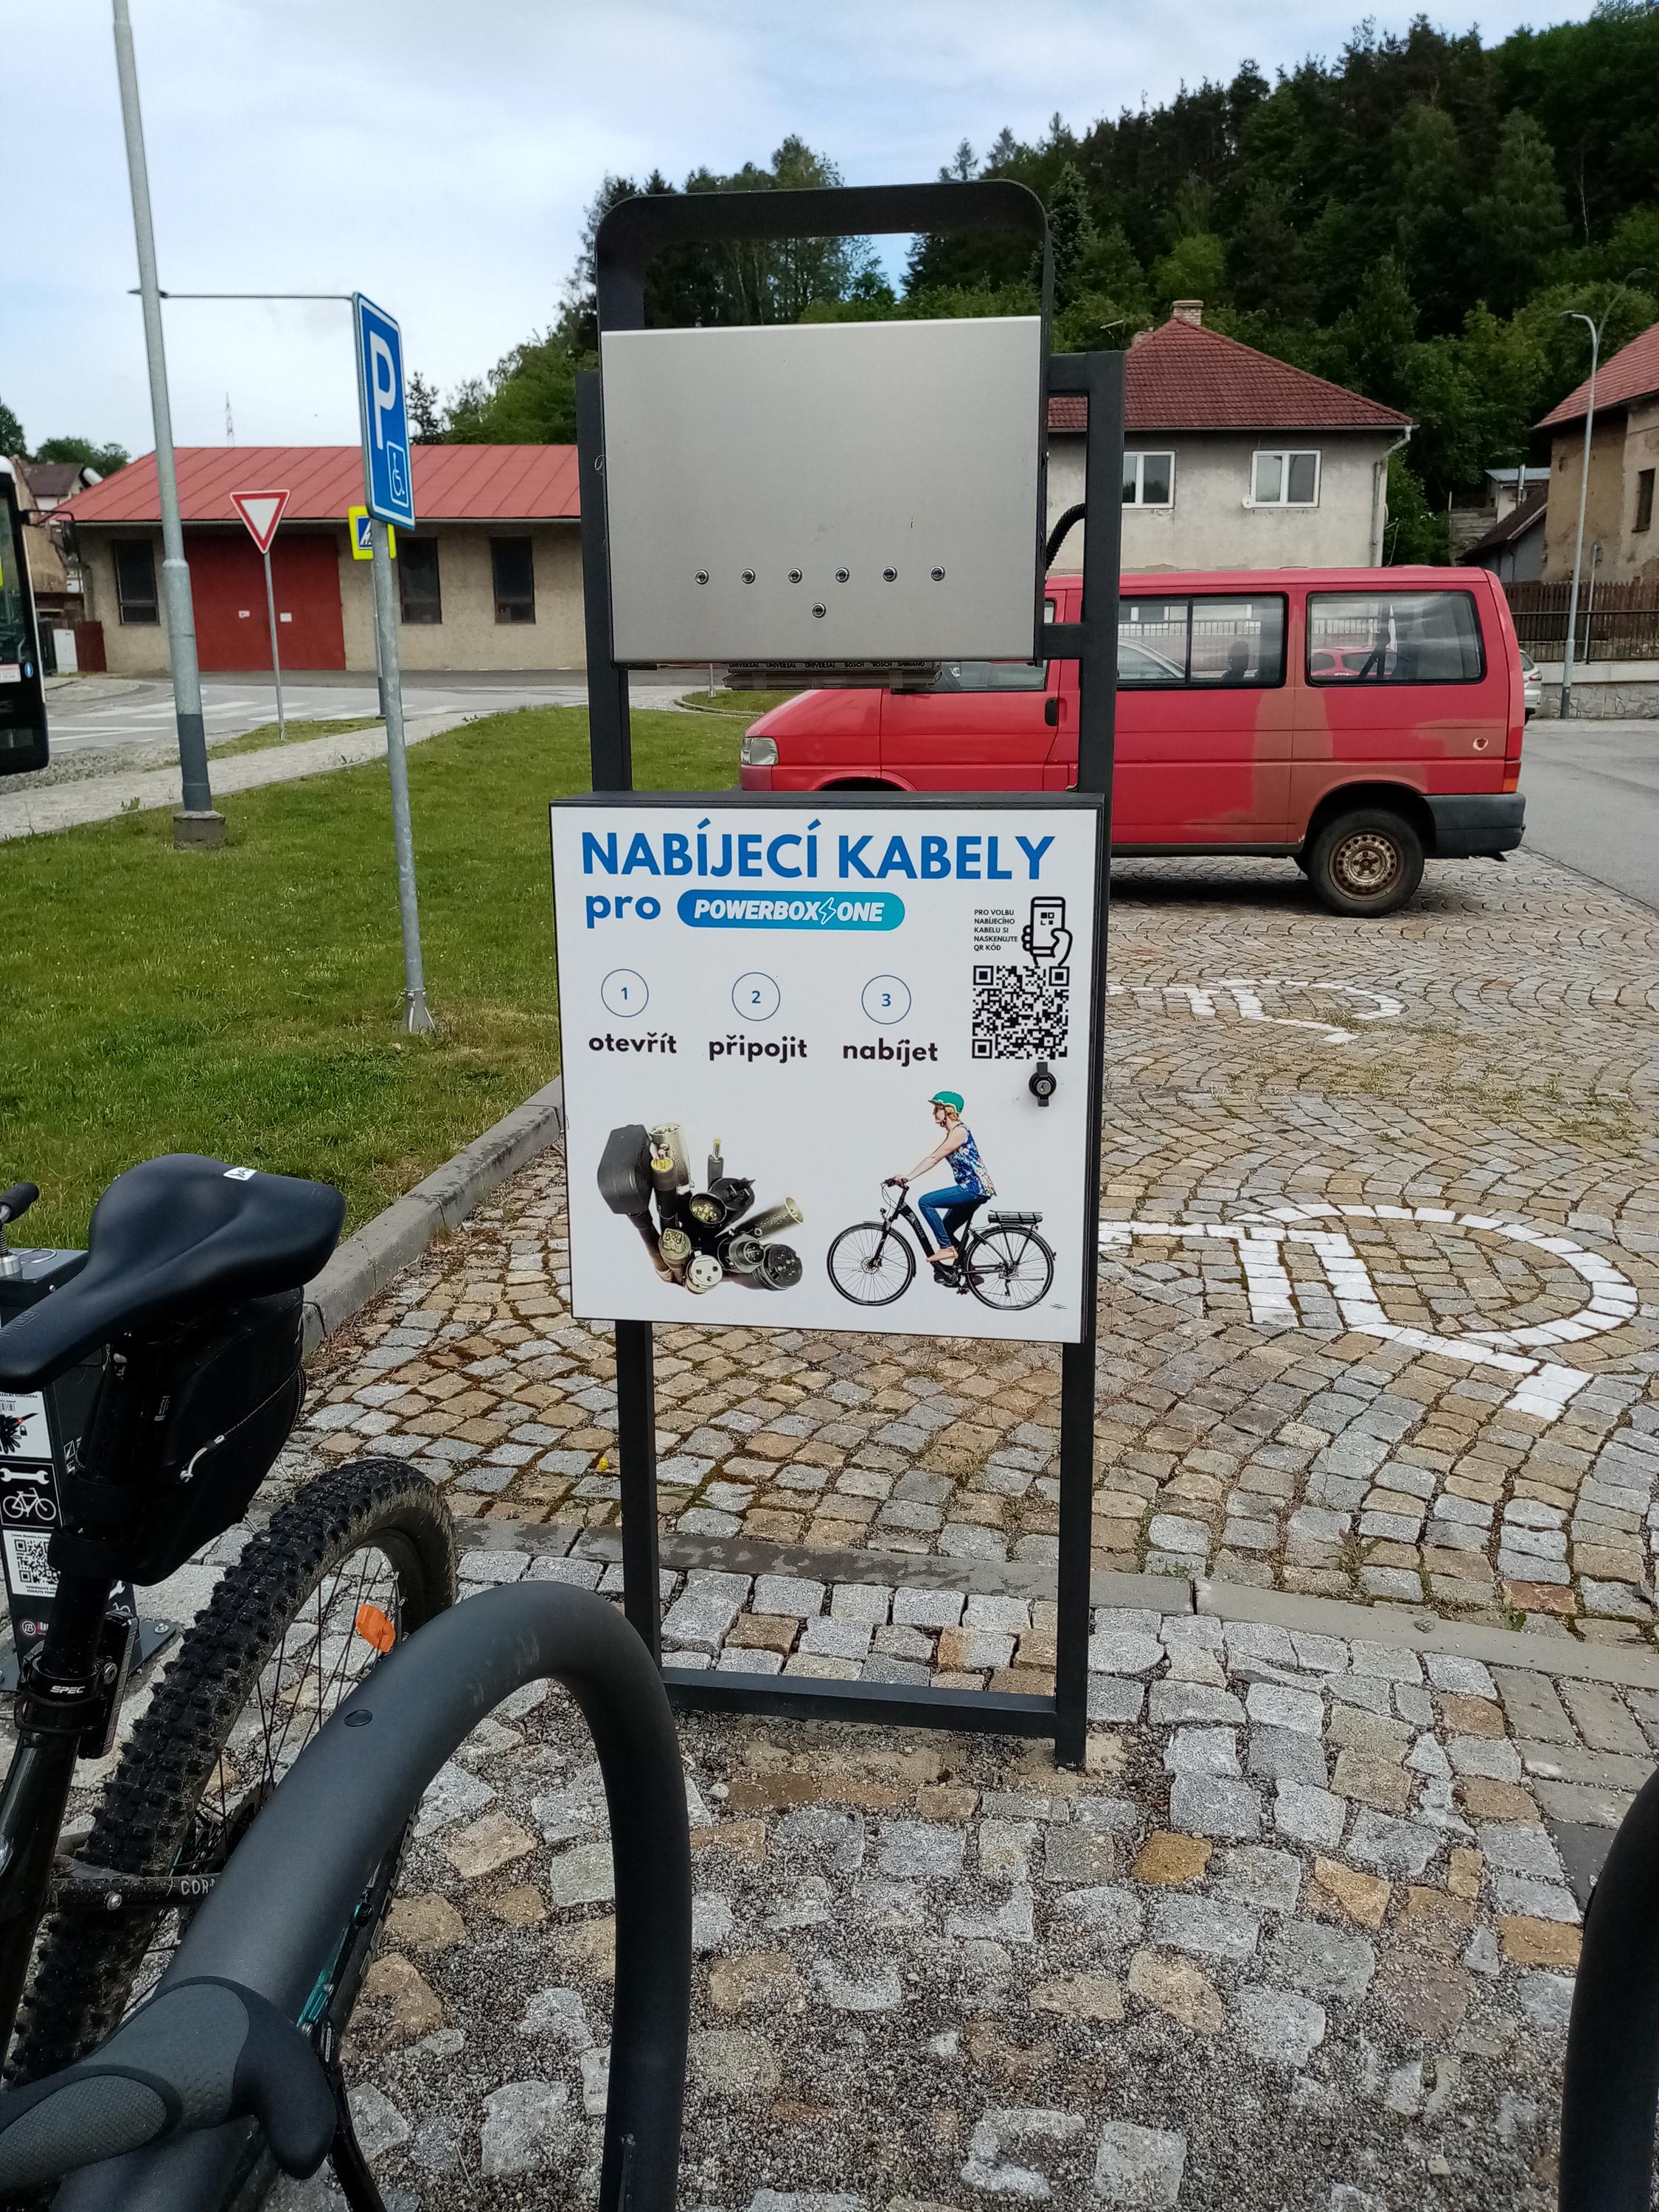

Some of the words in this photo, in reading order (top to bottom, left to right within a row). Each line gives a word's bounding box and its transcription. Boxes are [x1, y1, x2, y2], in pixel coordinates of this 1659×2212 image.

[370, 330, 397, 451] P
[582, 817, 821, 878] NABÍJECÍ
[838, 835, 1056, 880] KABELY
[586, 895, 661, 929] pro
[694, 899, 819, 922] POWERBOX
[836, 903, 886, 922] ONE
[974, 917, 1015, 925] NABÍJECÍHO
[985, 942, 1001, 951] KÓD
[621, 987, 627, 1000] 1
[751, 990, 761, 1004] 2
[881, 993, 891, 1007] 3
[588, 1032, 677, 1054] otevřít
[709, 1034, 807, 1064] připojit
[843, 1037, 939, 1068] nabíjet
